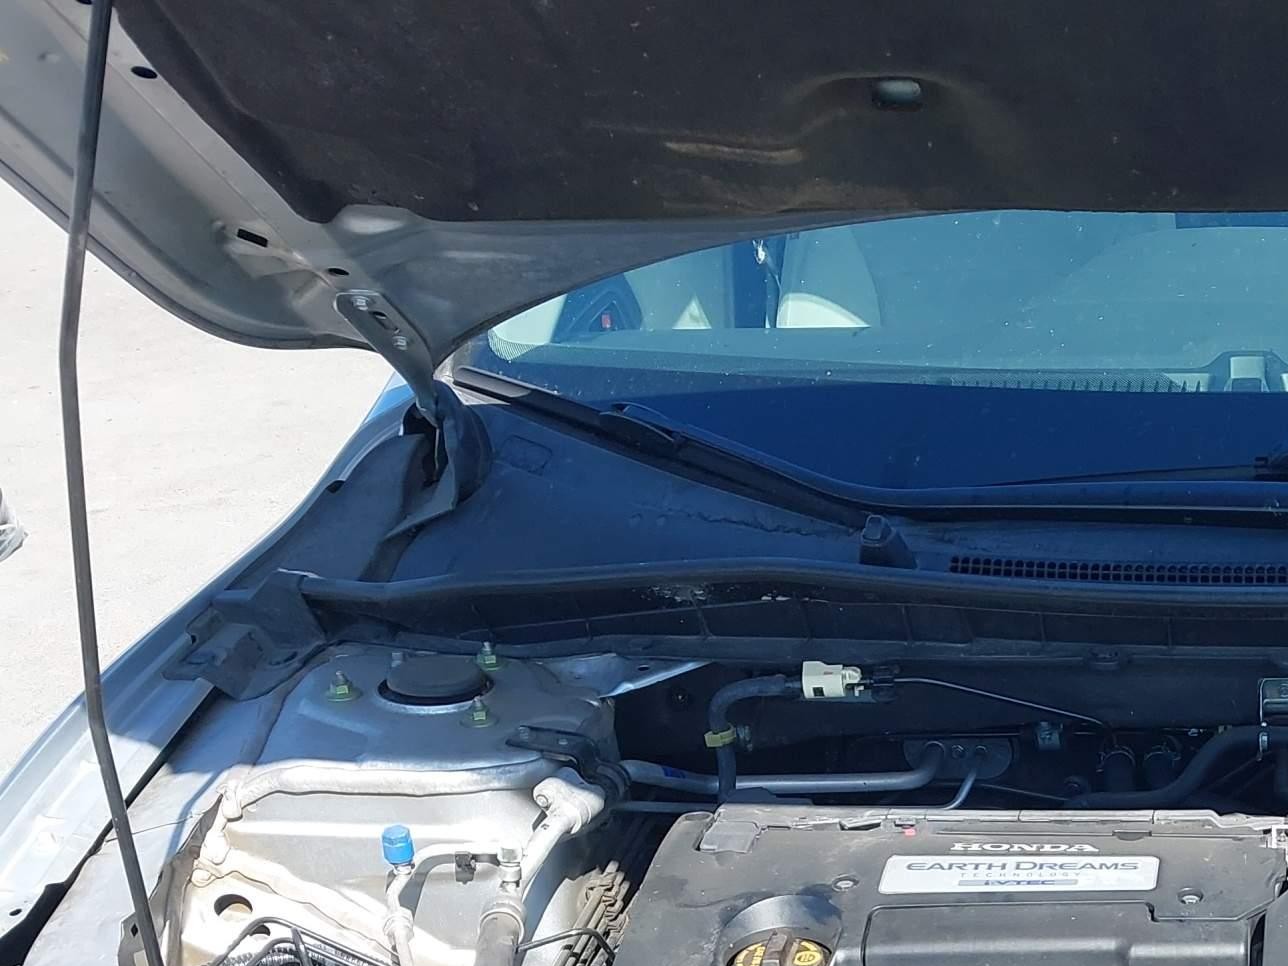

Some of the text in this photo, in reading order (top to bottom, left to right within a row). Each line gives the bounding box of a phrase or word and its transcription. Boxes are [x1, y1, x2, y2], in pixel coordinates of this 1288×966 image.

[950, 842, 1100, 852] HONDA
[906, 861, 1139, 871] EARTH DREAMS
